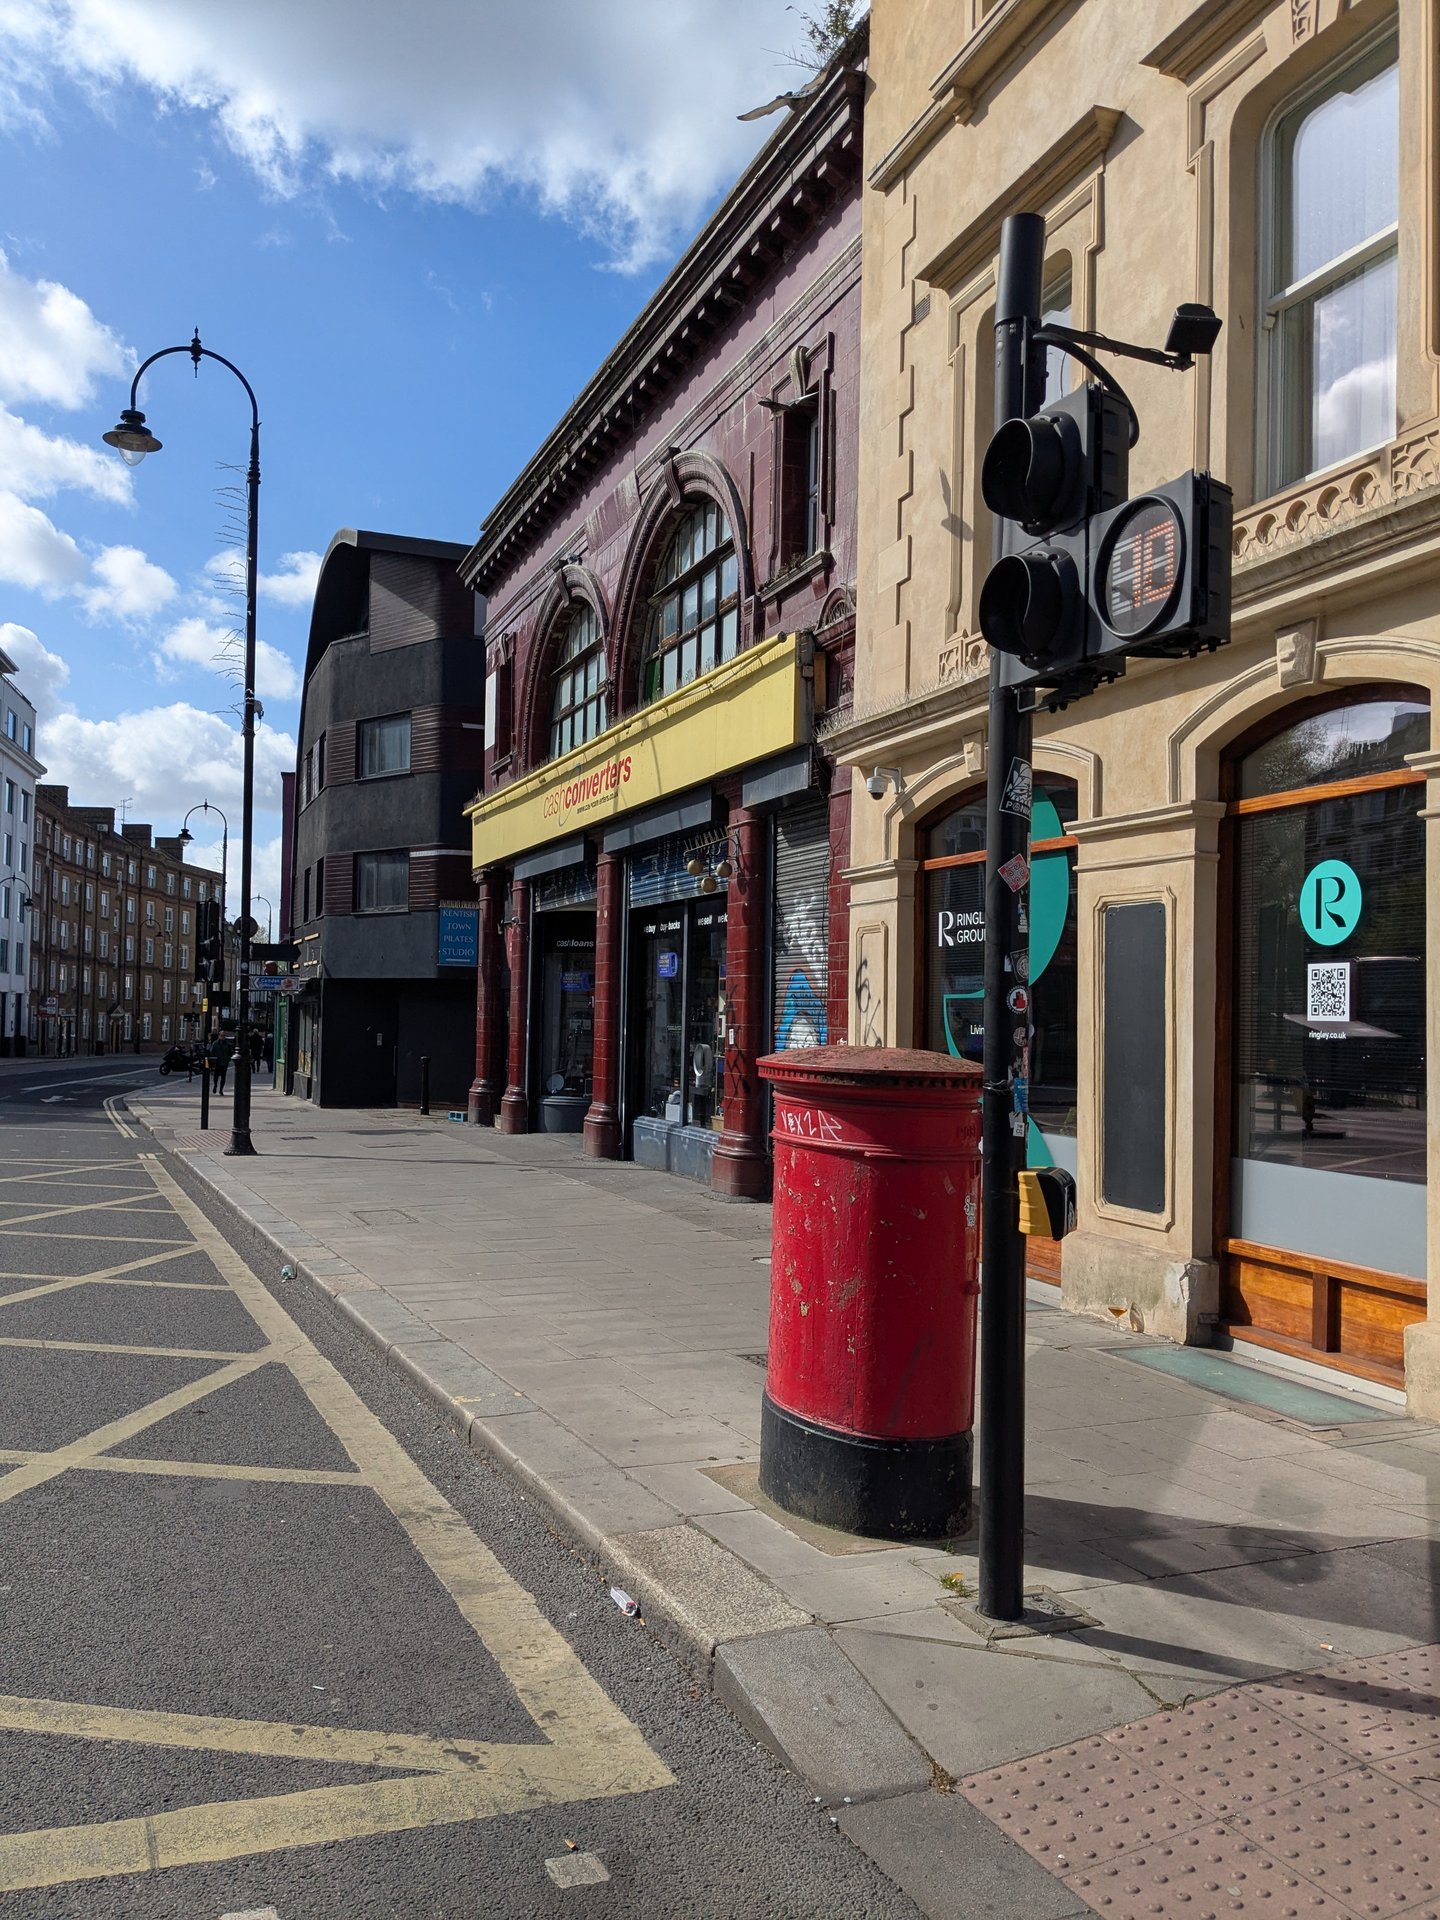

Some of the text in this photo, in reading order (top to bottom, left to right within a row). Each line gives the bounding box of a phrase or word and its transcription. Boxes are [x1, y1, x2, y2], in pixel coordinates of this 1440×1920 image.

[1315, 876, 1347, 930] R
[442, 909, 476, 918] KENTISH
[447, 922, 471, 930] TOWN
[938, 911, 954, 947] R
[443, 935, 474, 943] PILATES
[442, 947, 475, 957] STUDIO
[1308, 1030, 1347, 1040] ringley.co.uk
